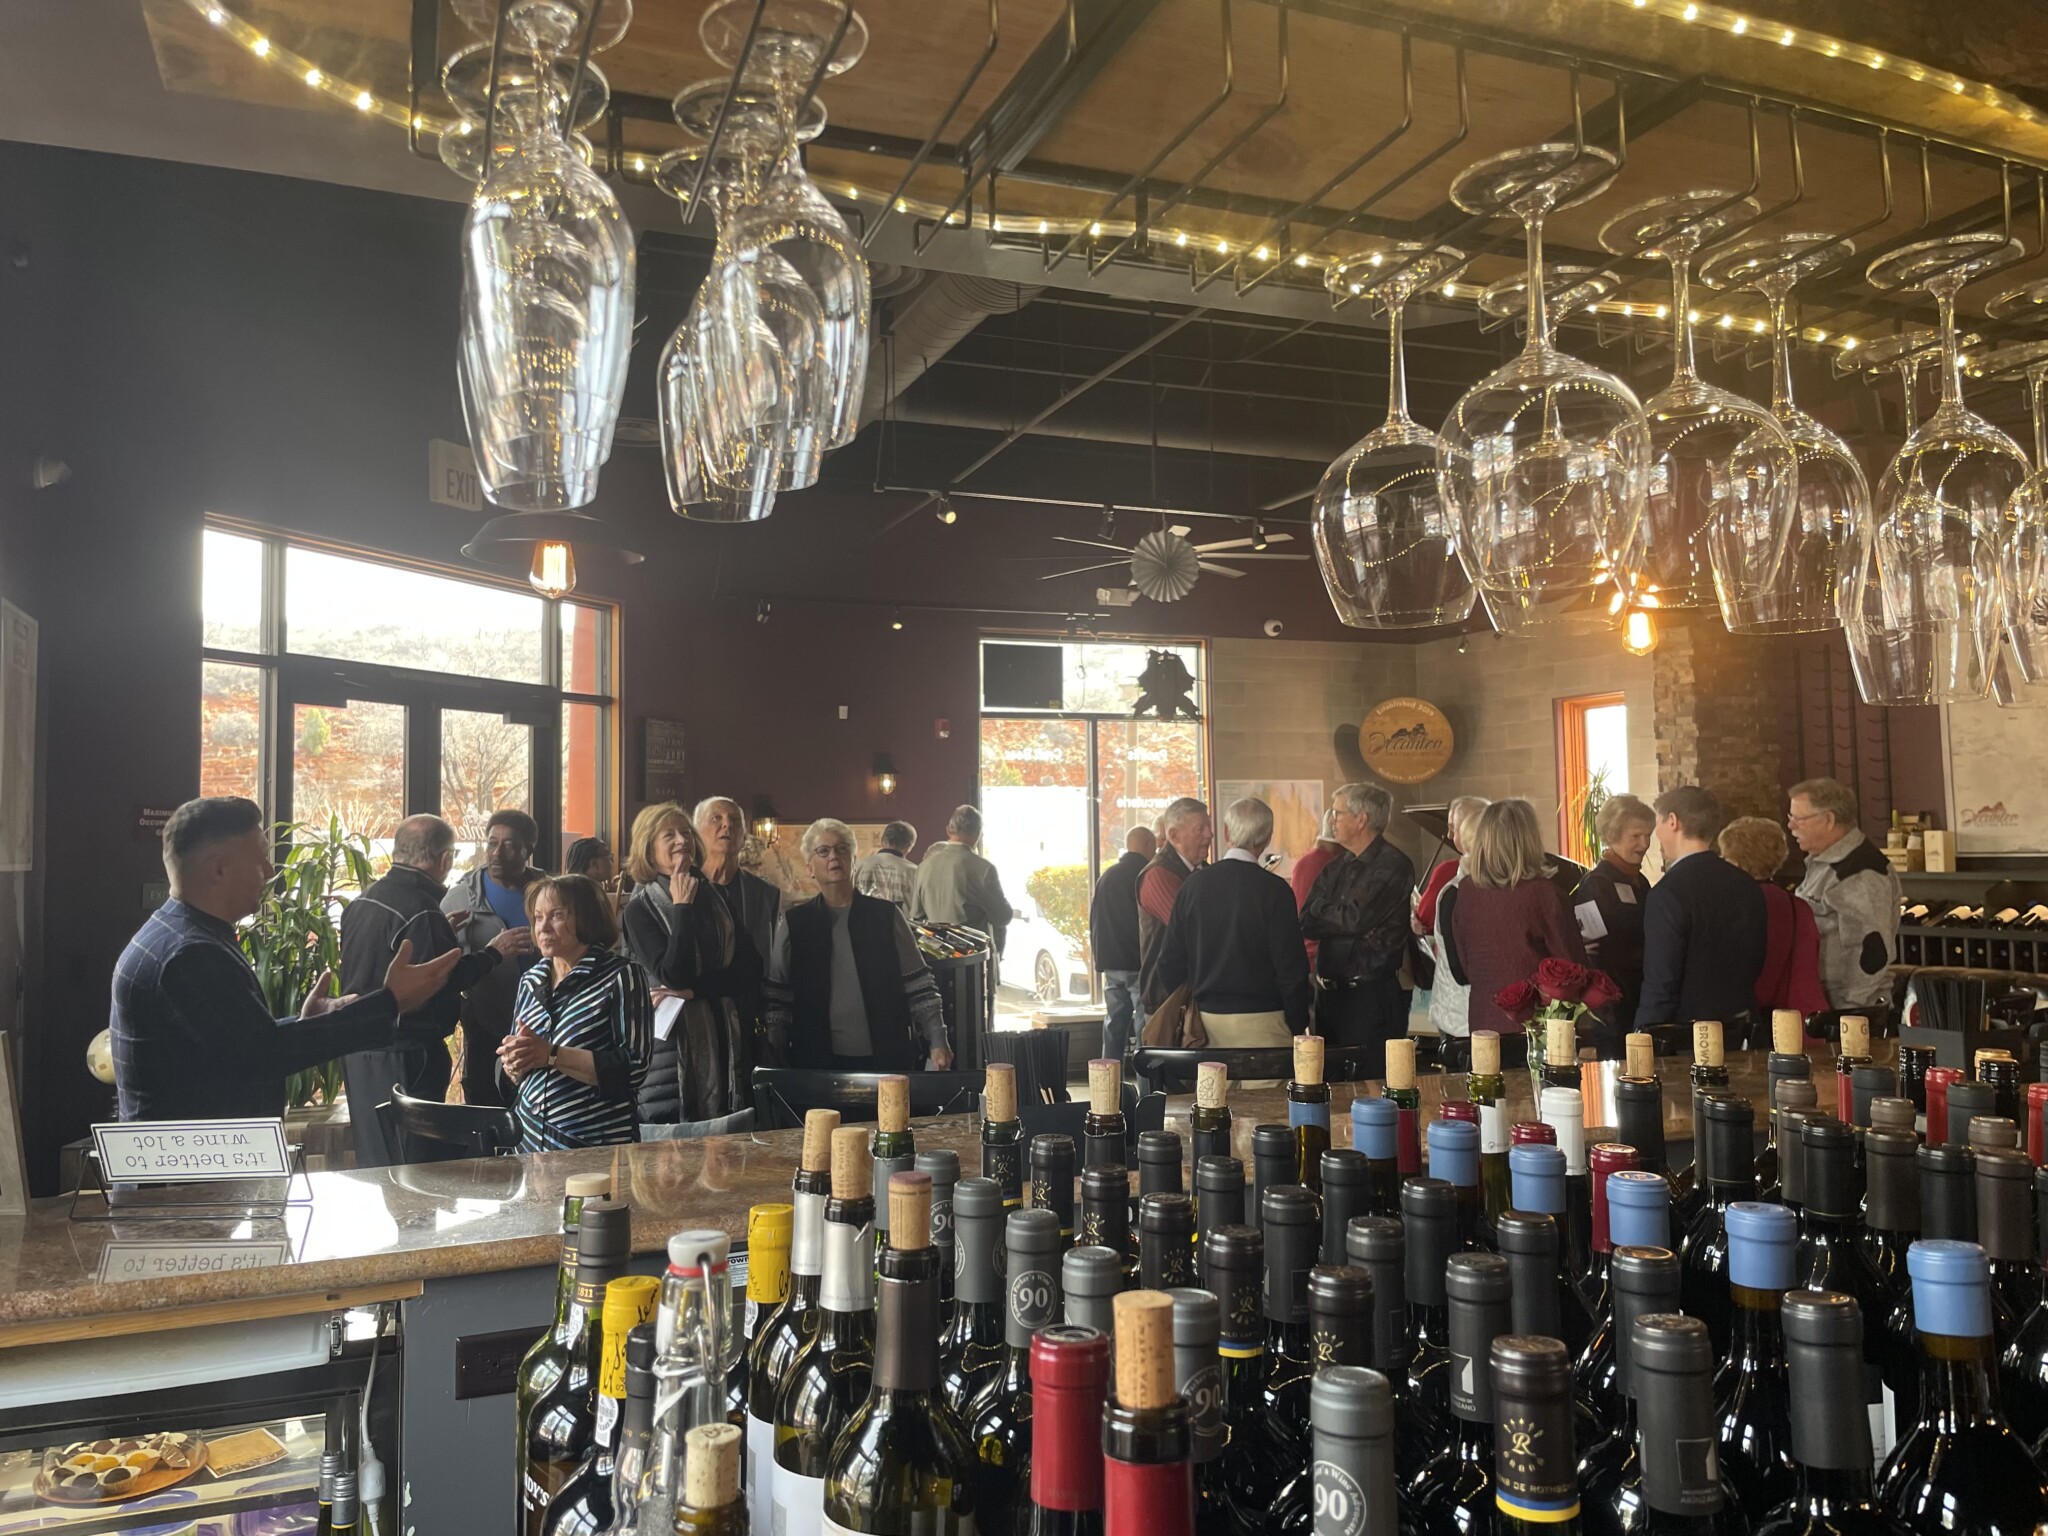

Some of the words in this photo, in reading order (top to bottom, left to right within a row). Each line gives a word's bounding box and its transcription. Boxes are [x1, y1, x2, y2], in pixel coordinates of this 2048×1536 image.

[446, 468, 478, 505] EXIT
[1376, 700, 1416, 716] Established
[143, 808, 176, 817] MAXIMU
[133, 1135, 167, 1151] lot
[171, 1135, 185, 1147] a
[192, 1133, 251, 1146] wine
[125, 1155, 148, 1170] to
[155, 1152, 229, 1169] better
[232, 1151, 268, 1167] it's
[1019, 1287, 1048, 1312] 90
[1314, 1482, 1348, 1522] 90
